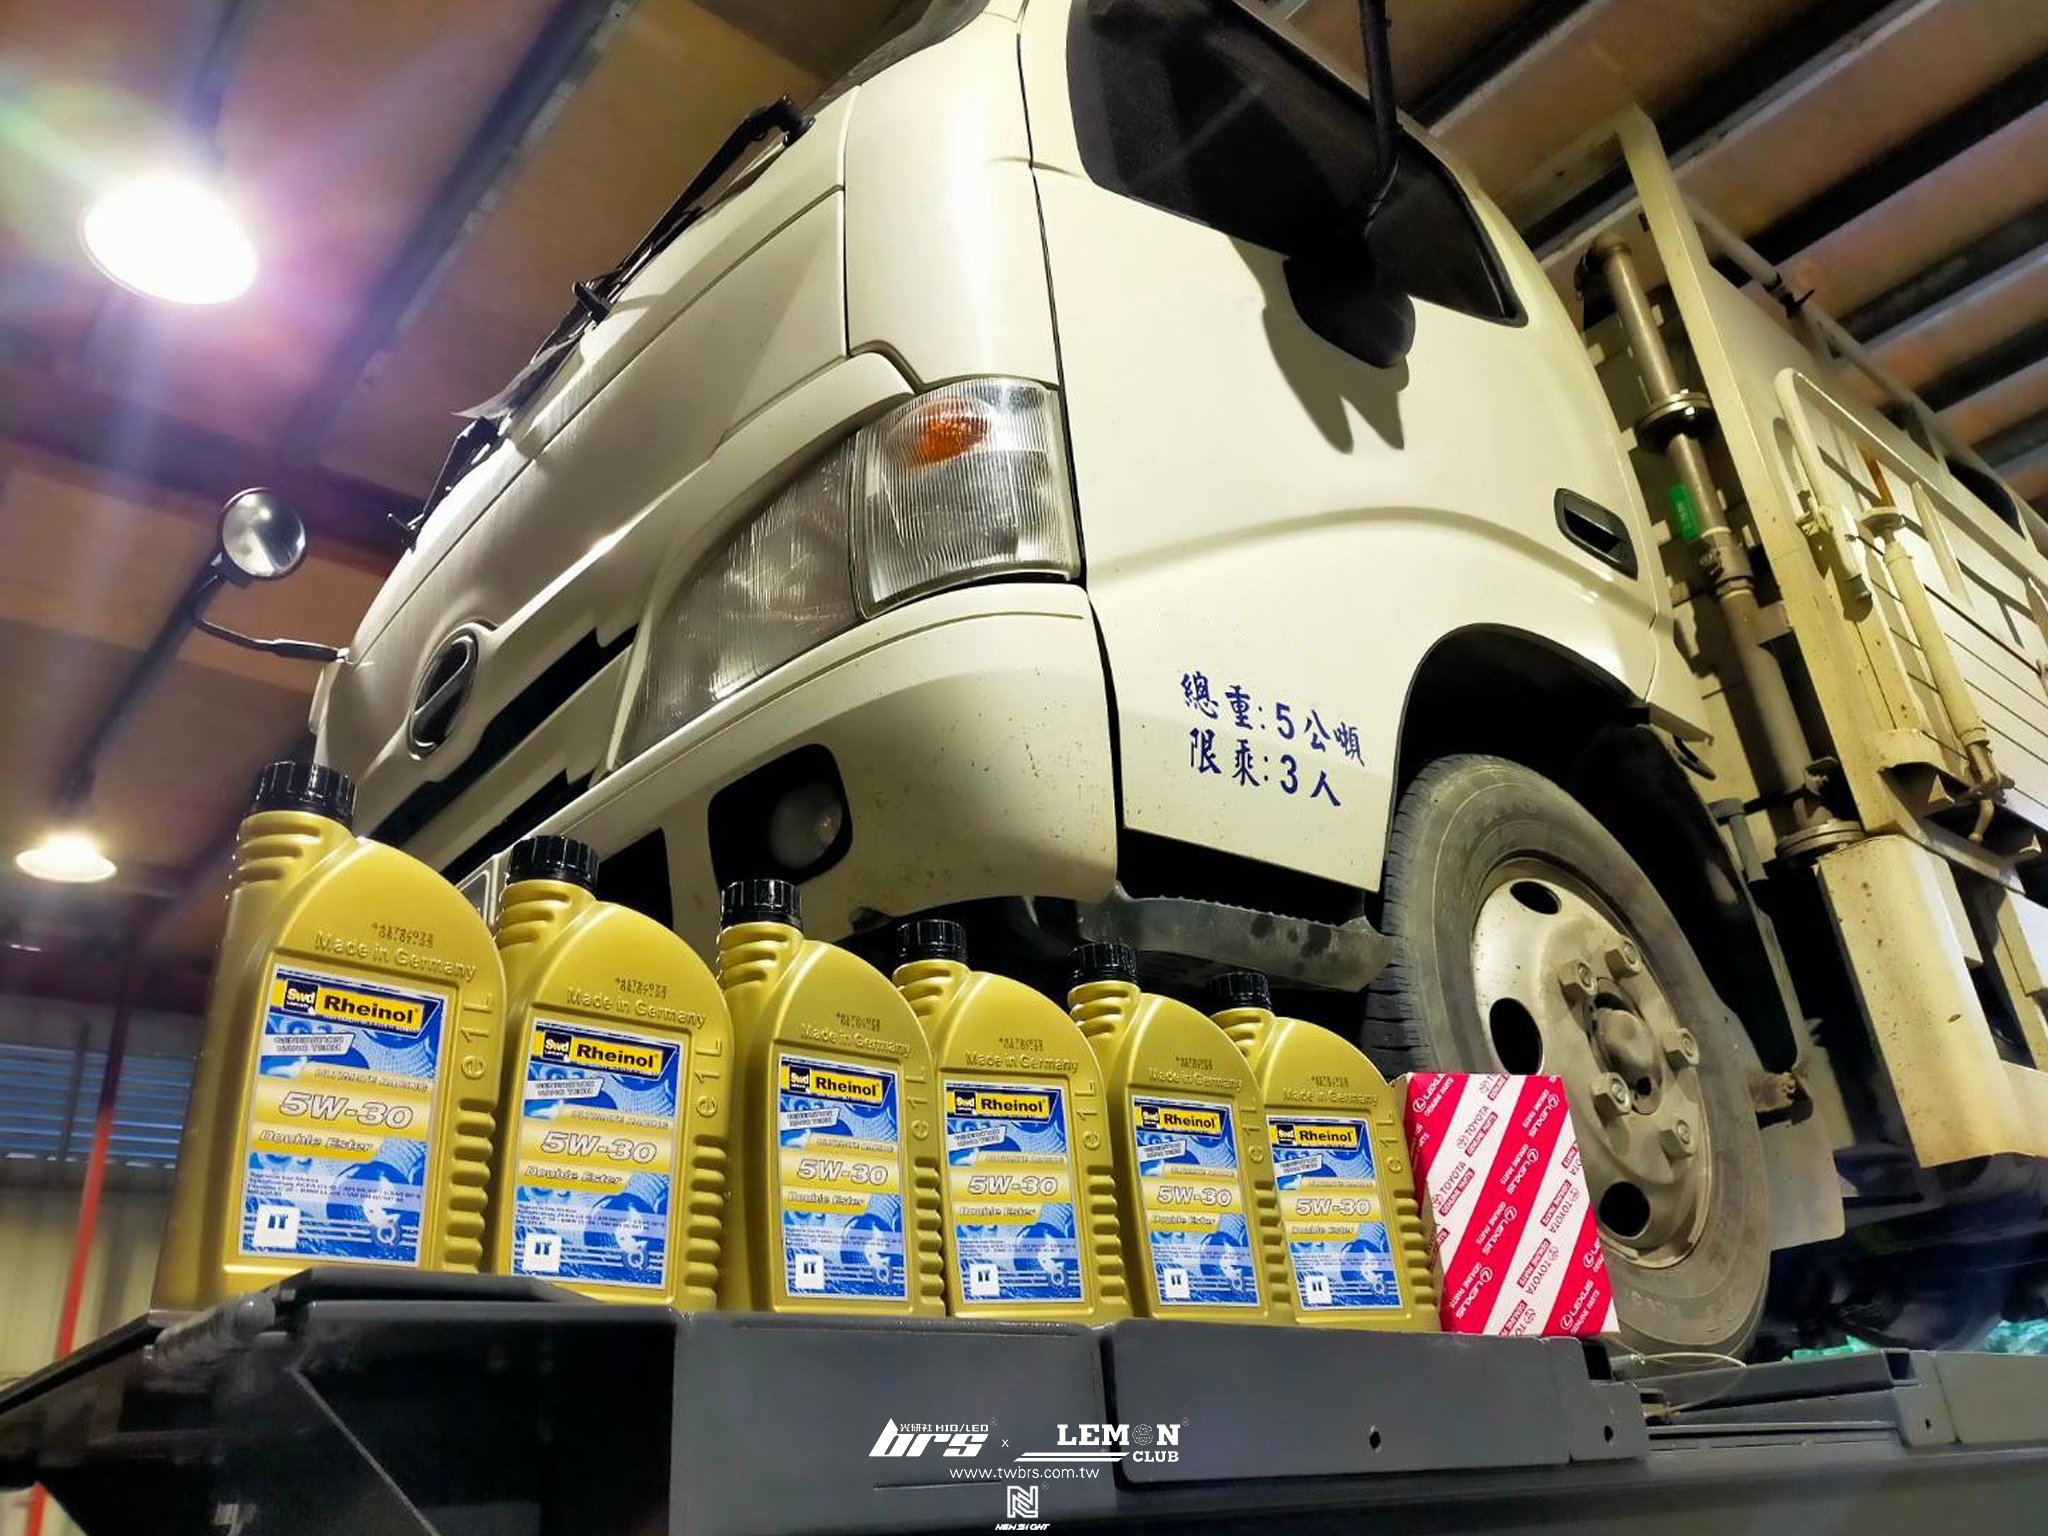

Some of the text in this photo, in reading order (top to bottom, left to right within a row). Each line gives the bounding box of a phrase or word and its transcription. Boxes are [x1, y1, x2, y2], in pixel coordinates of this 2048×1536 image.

[315, 931, 368, 959] Made
[373, 944, 387, 961] in
[394, 947, 477, 983] Germany
[287, 988, 315, 1004] Swd
[324, 995, 413, 1024] Rheinol
[566, 987, 612, 1010] Made
[617, 998, 630, 1013] in
[635, 1000, 706, 1029] Germany
[545, 1038, 569, 1052] Swd
[800, 1024, 910, 1058] Made in Germany
[577, 1044, 654, 1068] Rheinol
[965, 1052, 1078, 1073] Made in Germany
[815, 1076, 877, 1096] Rheinol
[981, 1098, 1043, 1113] Rheinol
[1282, 1087, 1312, 1102] Made
[1328, 1090, 1381, 1107] Germany
[279, 1092, 414, 1128] 5W-30
[1465, 1105, 1489, 1136] TOYOTA
[1164, 1114, 1215, 1128] Rheinol
[260, 1129, 373, 1151] Double Ester
[1300, 1130, 1351, 1142] Rheinol
[540, 1131, 657, 1163] 5W-30
[525, 1165, 623, 1185] Double Ester
[797, 1157, 888, 1186] 5W-30
[1441, 1161, 1466, 1194] TOYOTA
[967, 1175, 1058, 1196] 5W-30
[1157, 1186, 1232, 1206] 5W-30
[959, 1206, 1001, 1216] Double
[1296, 1198, 1371, 1215] 5W-30
[1549, 1201, 1573, 1233] TOYOTA
[1525, 1261, 1551, 1294] TOYOTA
